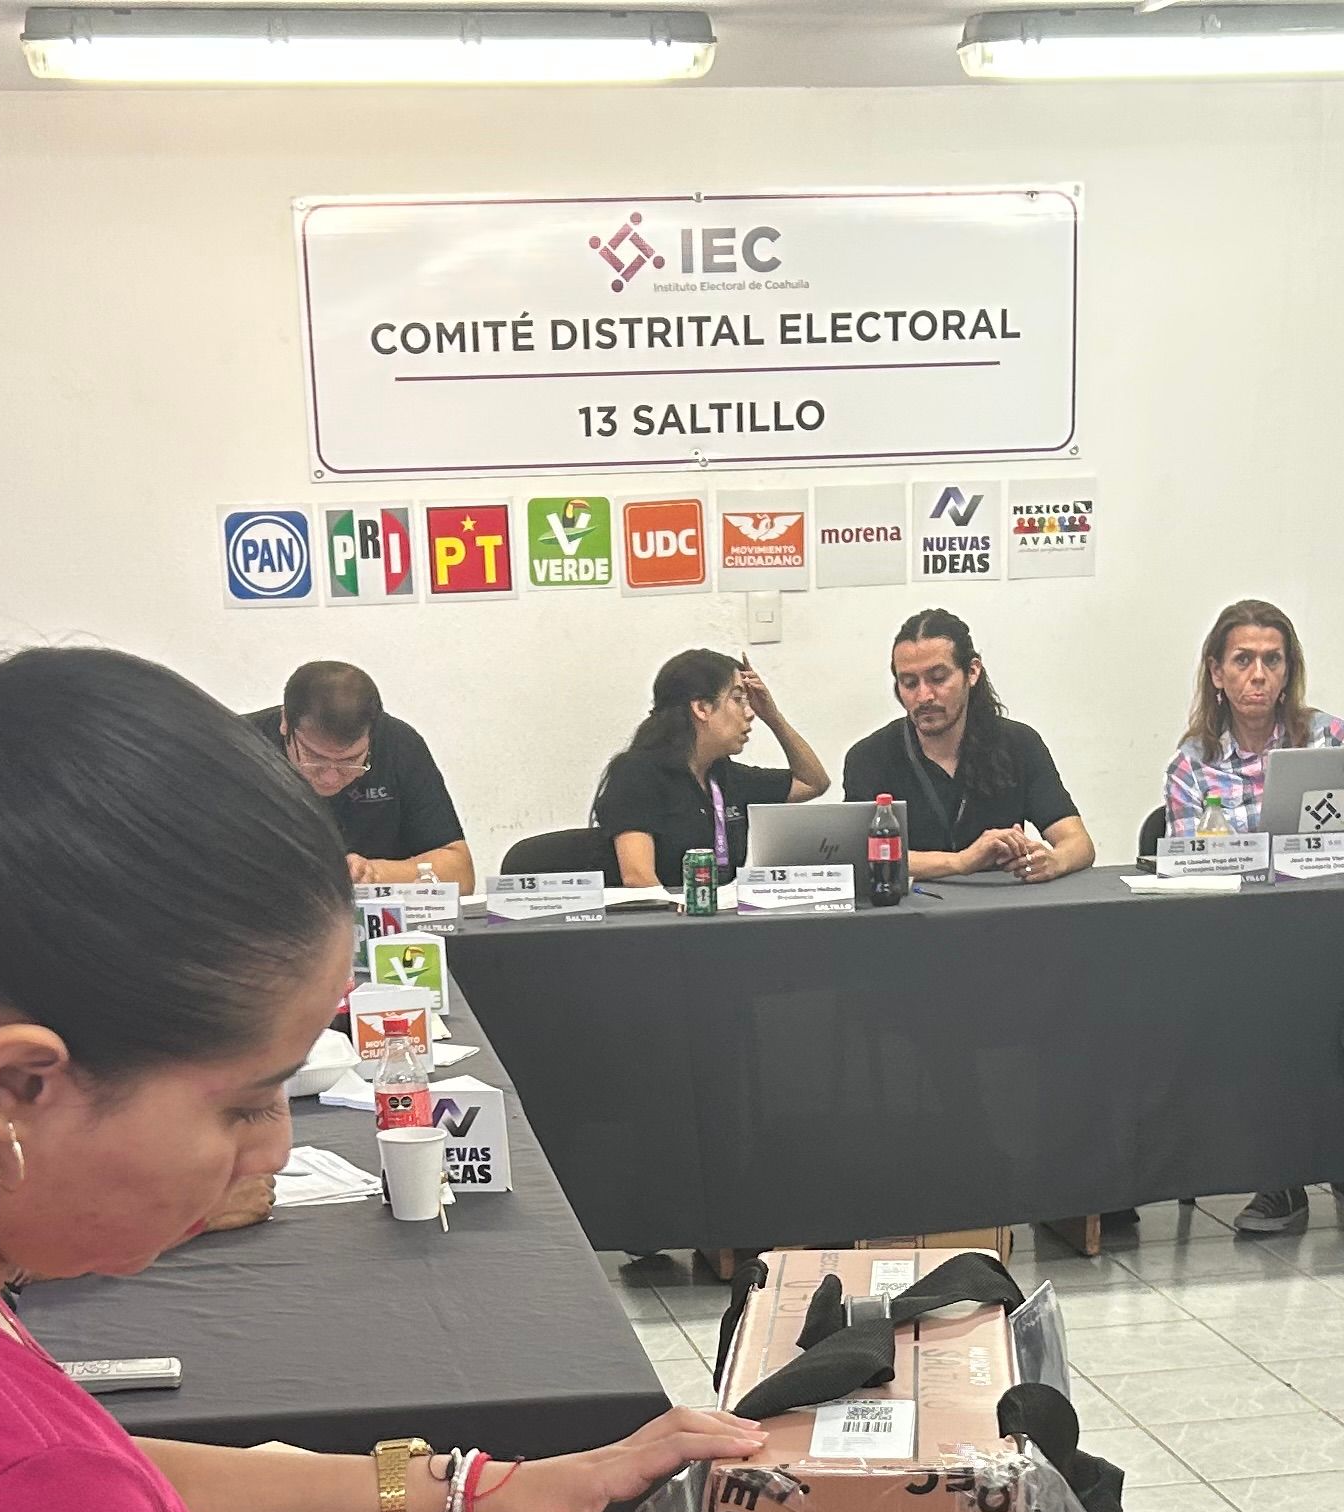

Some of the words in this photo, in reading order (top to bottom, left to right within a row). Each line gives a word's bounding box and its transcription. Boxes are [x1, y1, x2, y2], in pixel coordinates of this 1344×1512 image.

[681, 226, 782, 273] IEC
[653, 282, 698, 293] Instituto
[699, 280, 746, 292] Electoral
[748, 280, 762, 291] de
[764, 279, 810, 290] Coahuila
[371, 311, 535, 355] COMITÉ
[550, 314, 765, 350] DISTRITAL
[779, 307, 1021, 345] ELECTORAL
[578, 405, 618, 437] 13
[633, 400, 825, 436] SALTILLO
[1012, 504, 1070, 515] MEXICO
[820, 523, 902, 545] morena
[1019, 535, 1087, 546] AVANTE
[333, 519, 402, 577] PRI
[632, 529, 697, 558] UDC
[730, 544, 796, 556] MOVIMIENTO
[922, 536, 990, 552] NUEVAS
[243, 537, 296, 573] PAN
[435, 535, 504, 586] PT
[724, 555, 803, 568] CIUDADANO
[532, 557, 609, 582] VERDE
[923, 554, 990, 574] IDEAS
[365, 786, 387, 799] IEC
[1190, 839, 1206, 852] 13
[1305, 837, 1322, 849] 13
[770, 869, 787, 881] 13
[519, 877, 537, 890] 13
[374, 886, 392, 897] 13
[445, 1147, 491, 1162] EVAS
[448, 1164, 492, 1184] EAS
